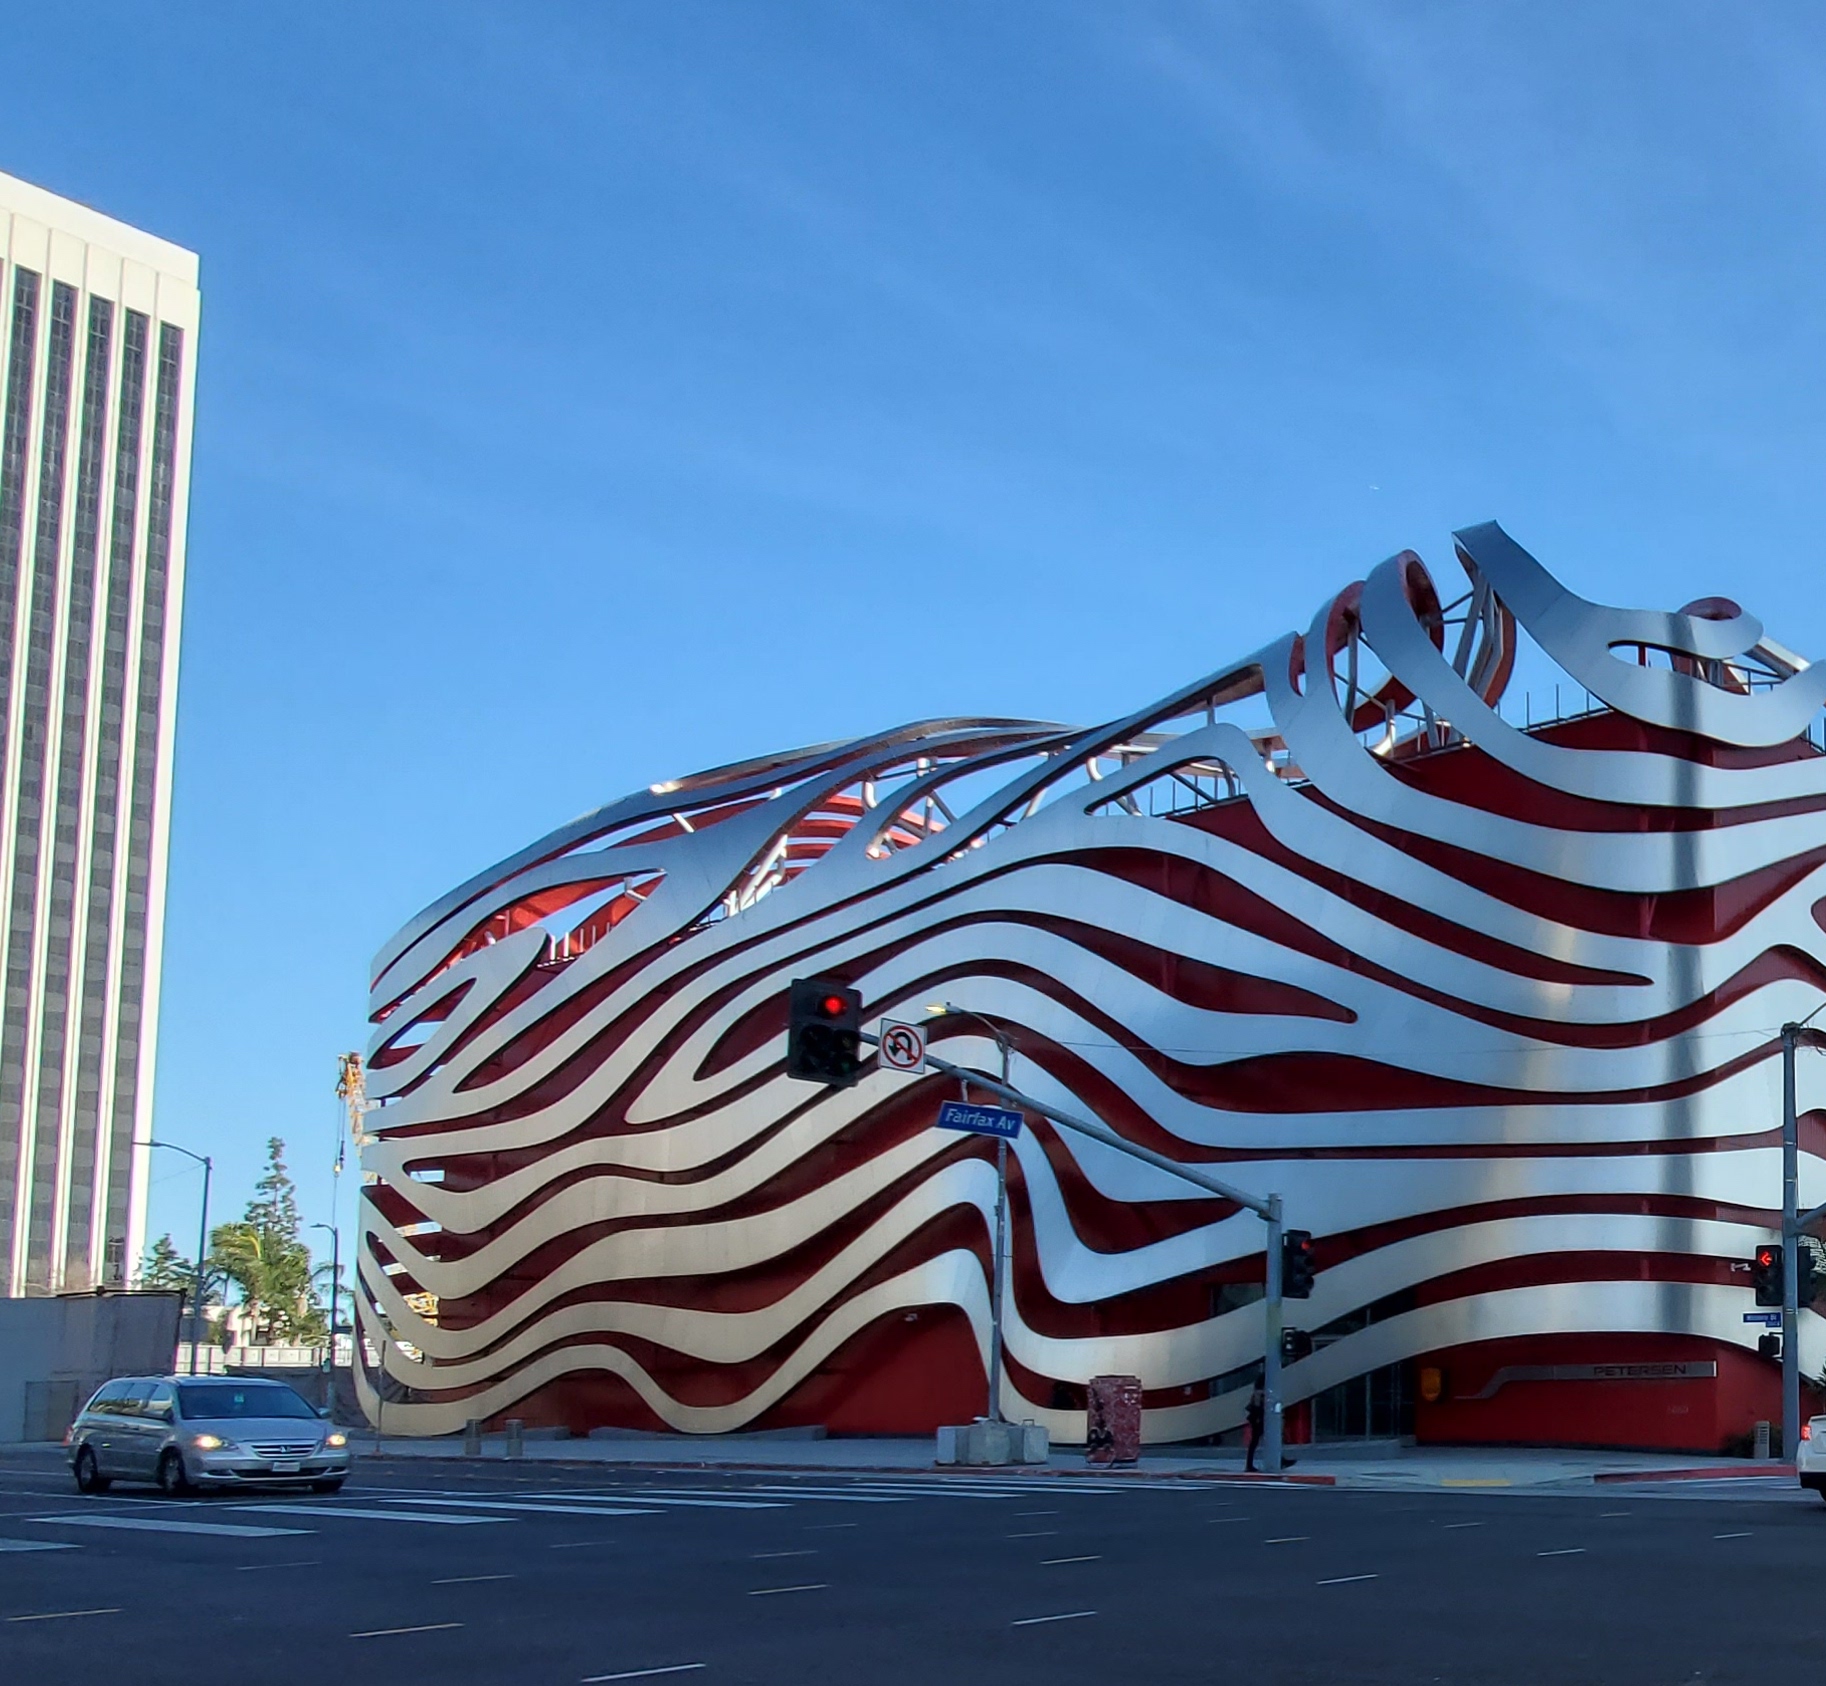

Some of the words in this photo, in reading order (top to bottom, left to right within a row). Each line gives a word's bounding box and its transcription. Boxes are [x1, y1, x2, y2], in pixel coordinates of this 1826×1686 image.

[945, 1108, 995, 1127] Fairfax
[996, 1115, 1016, 1131] Av
[1593, 1364, 1687, 1376] PETERSEN
